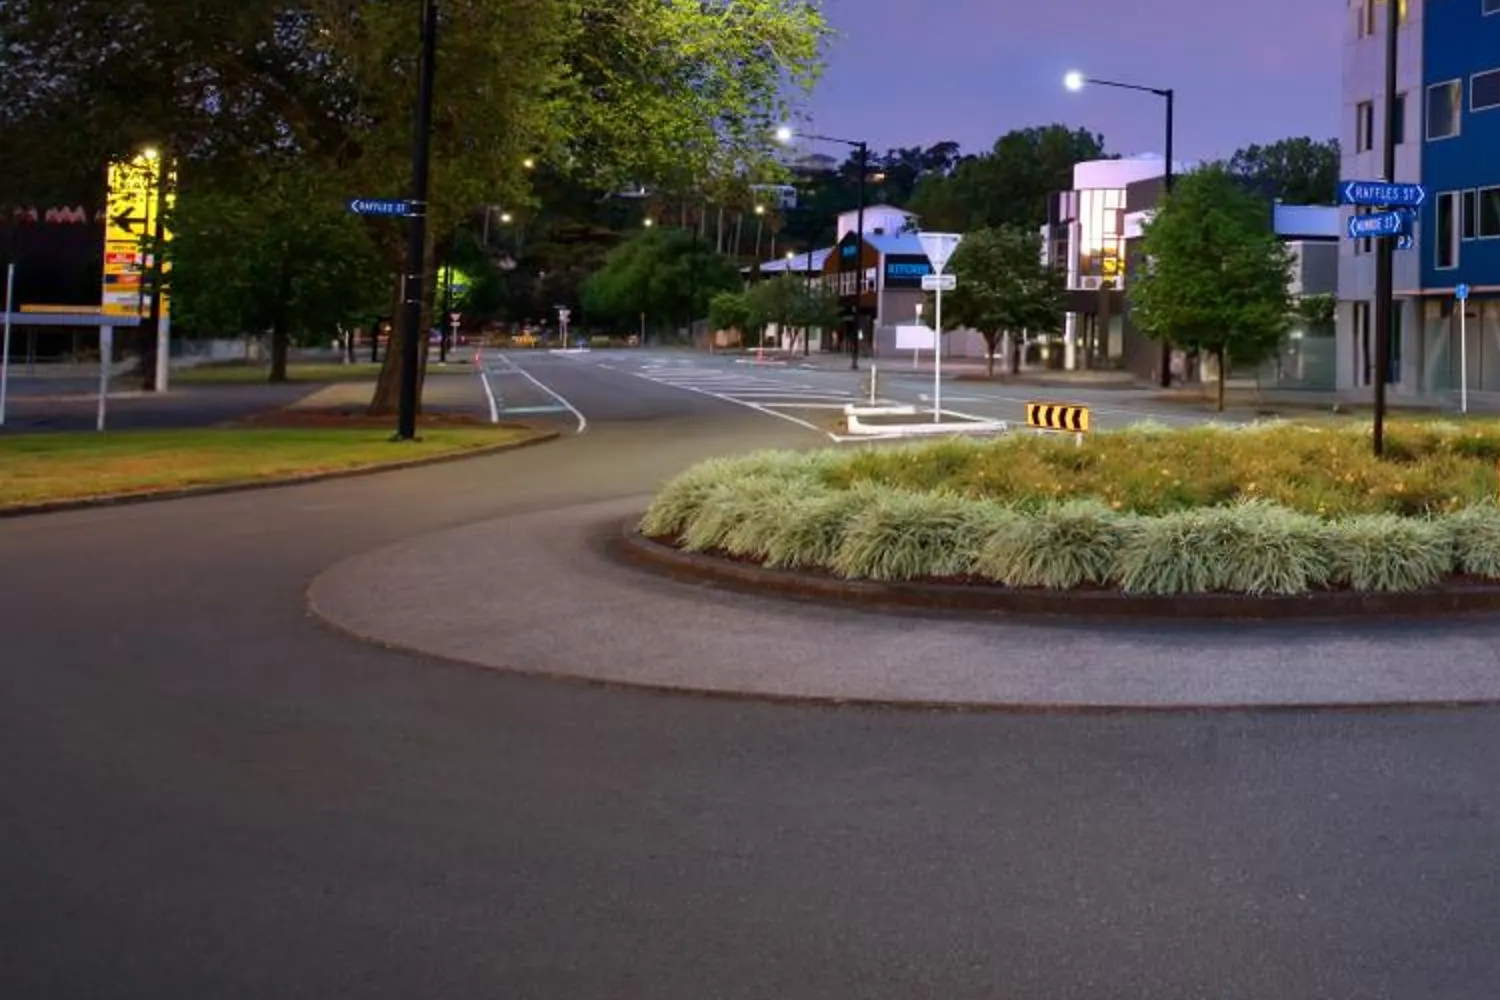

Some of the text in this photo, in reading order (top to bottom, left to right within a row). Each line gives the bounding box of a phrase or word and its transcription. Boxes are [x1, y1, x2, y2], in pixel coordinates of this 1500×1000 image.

[1355, 186, 1415, 201] RAFFLES ST
[359, 201, 394, 213] RAFFLES
